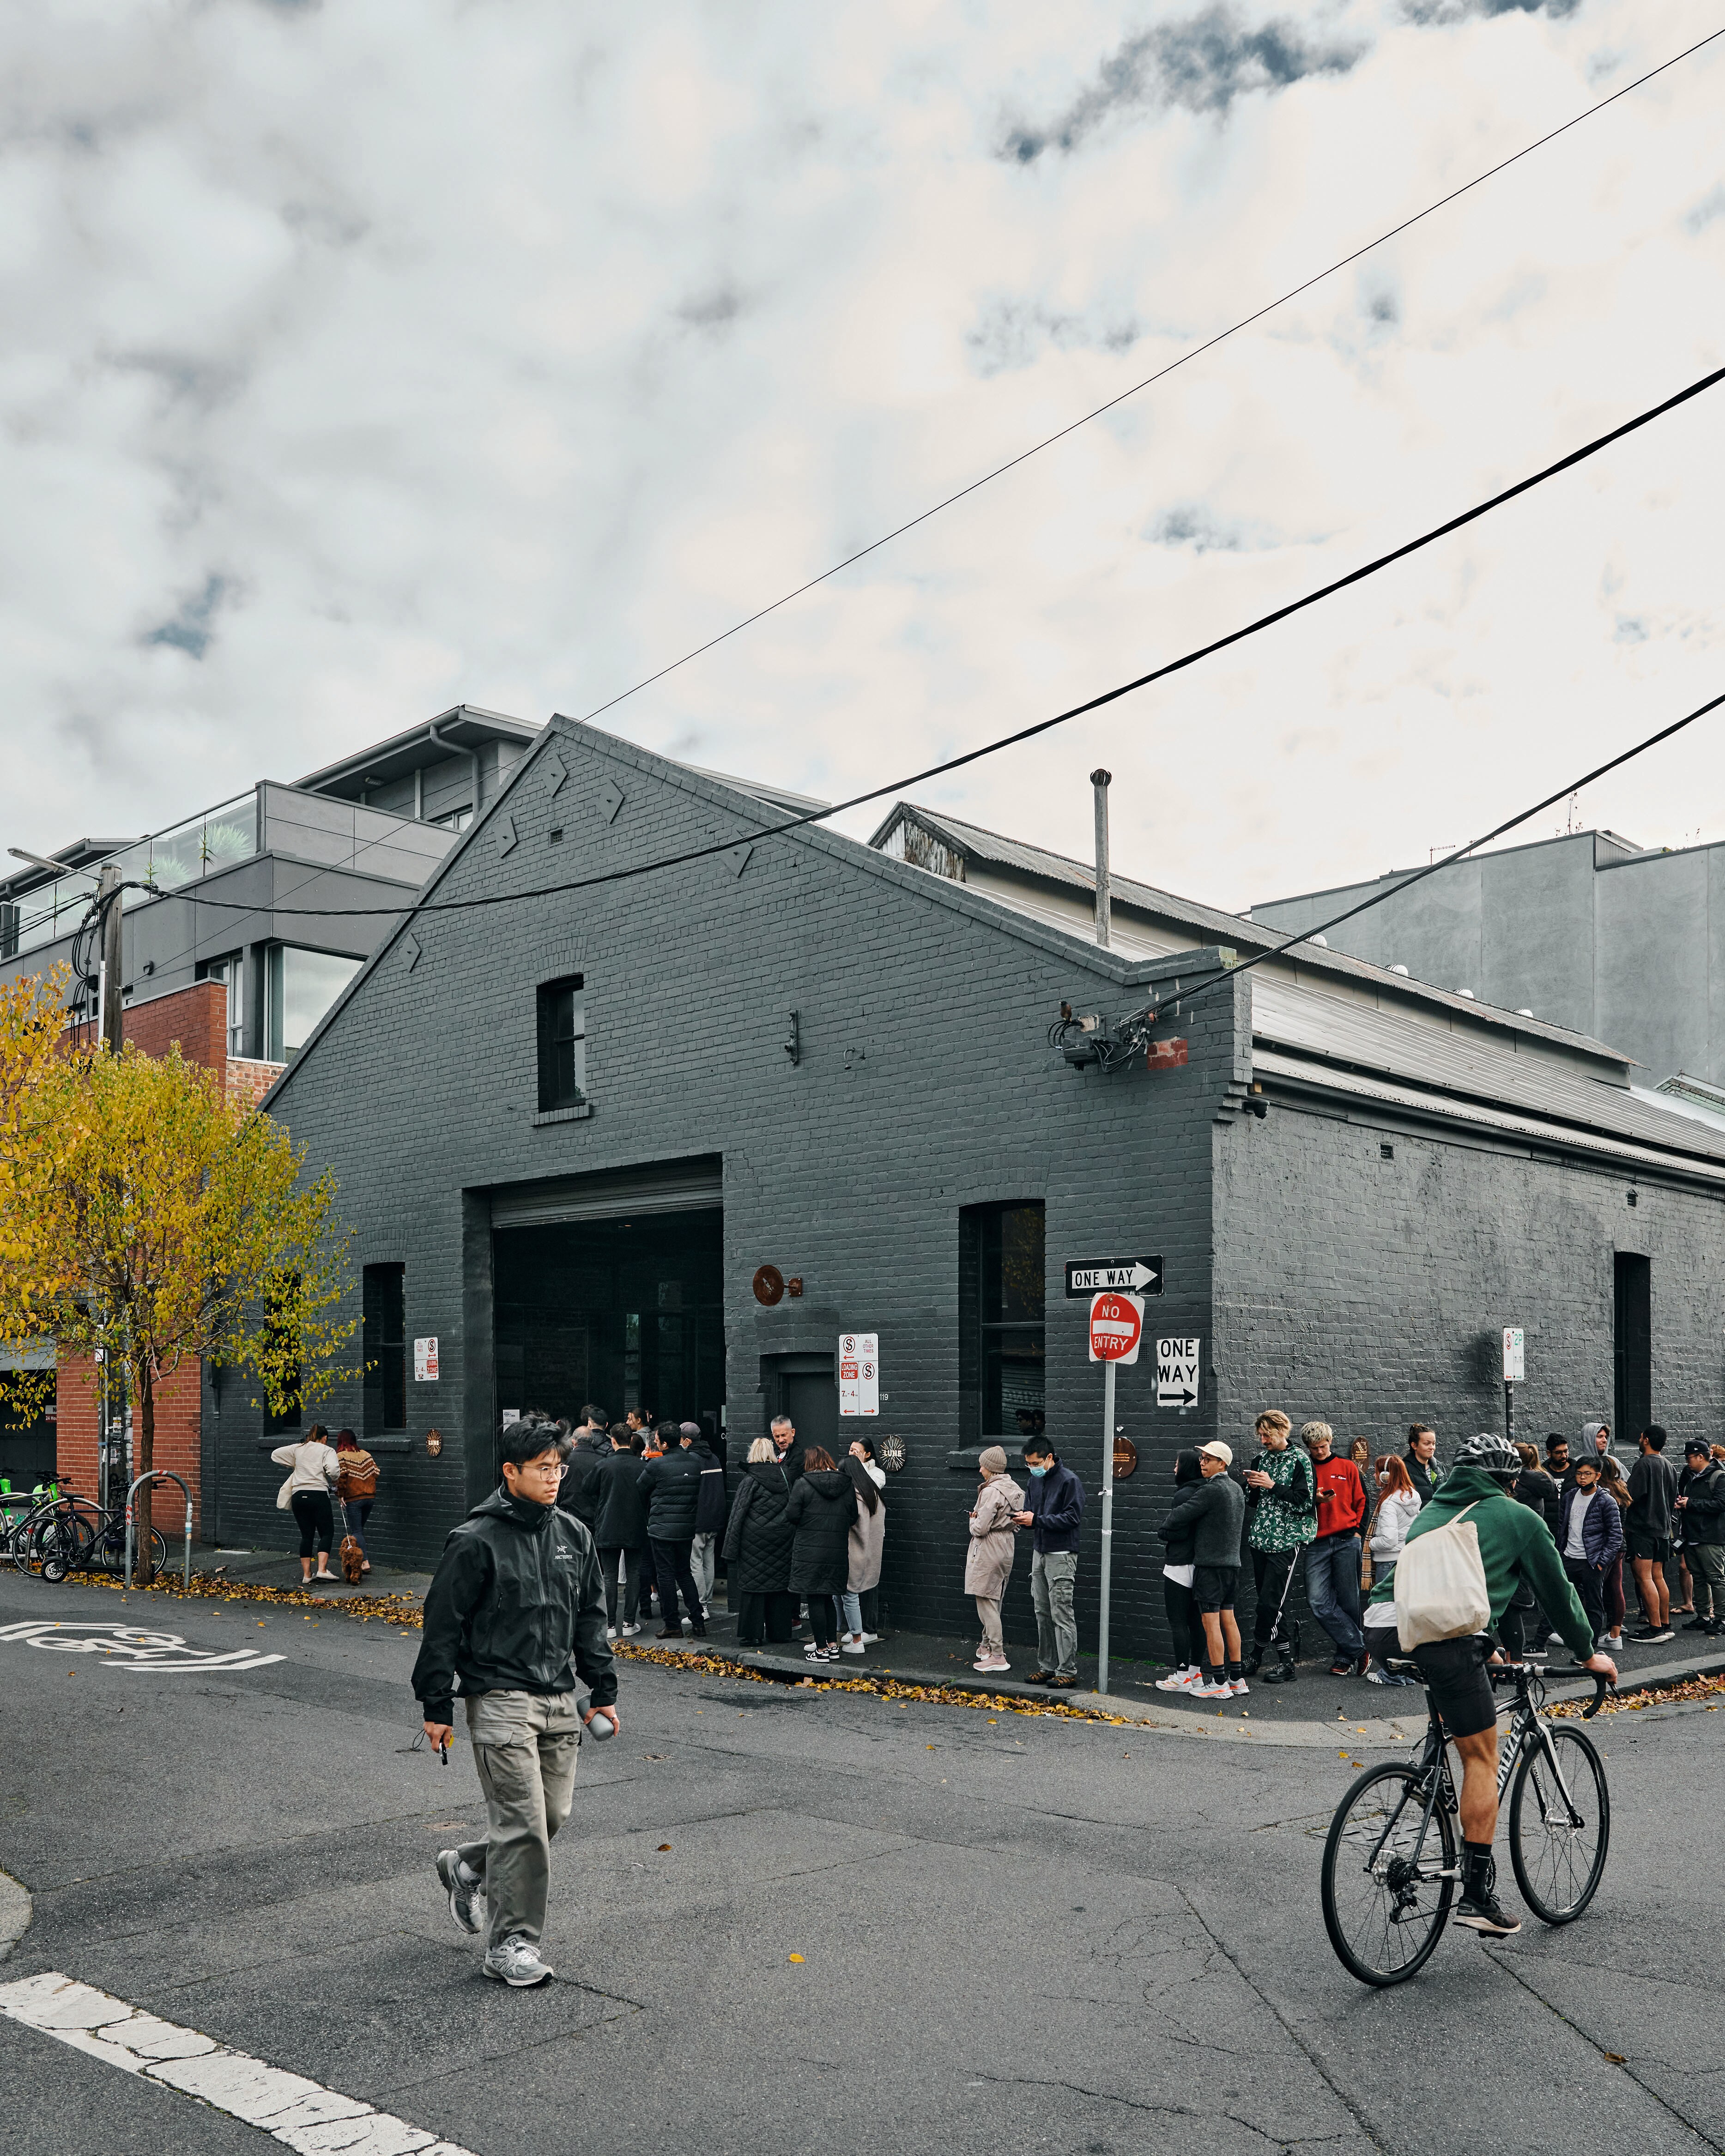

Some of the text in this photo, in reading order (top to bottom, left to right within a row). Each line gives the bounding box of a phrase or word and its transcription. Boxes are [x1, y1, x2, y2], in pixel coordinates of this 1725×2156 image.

[1075, 1269, 1133, 1286] ONE WAY
[1102, 1305, 1120, 1318] NO
[1094, 1335, 1129, 1351] ENTRY
[1514, 1334, 1522, 1345] 2P
[1161, 1340, 1195, 1358] ONE
[1158, 1365, 1197, 1383] WAY
